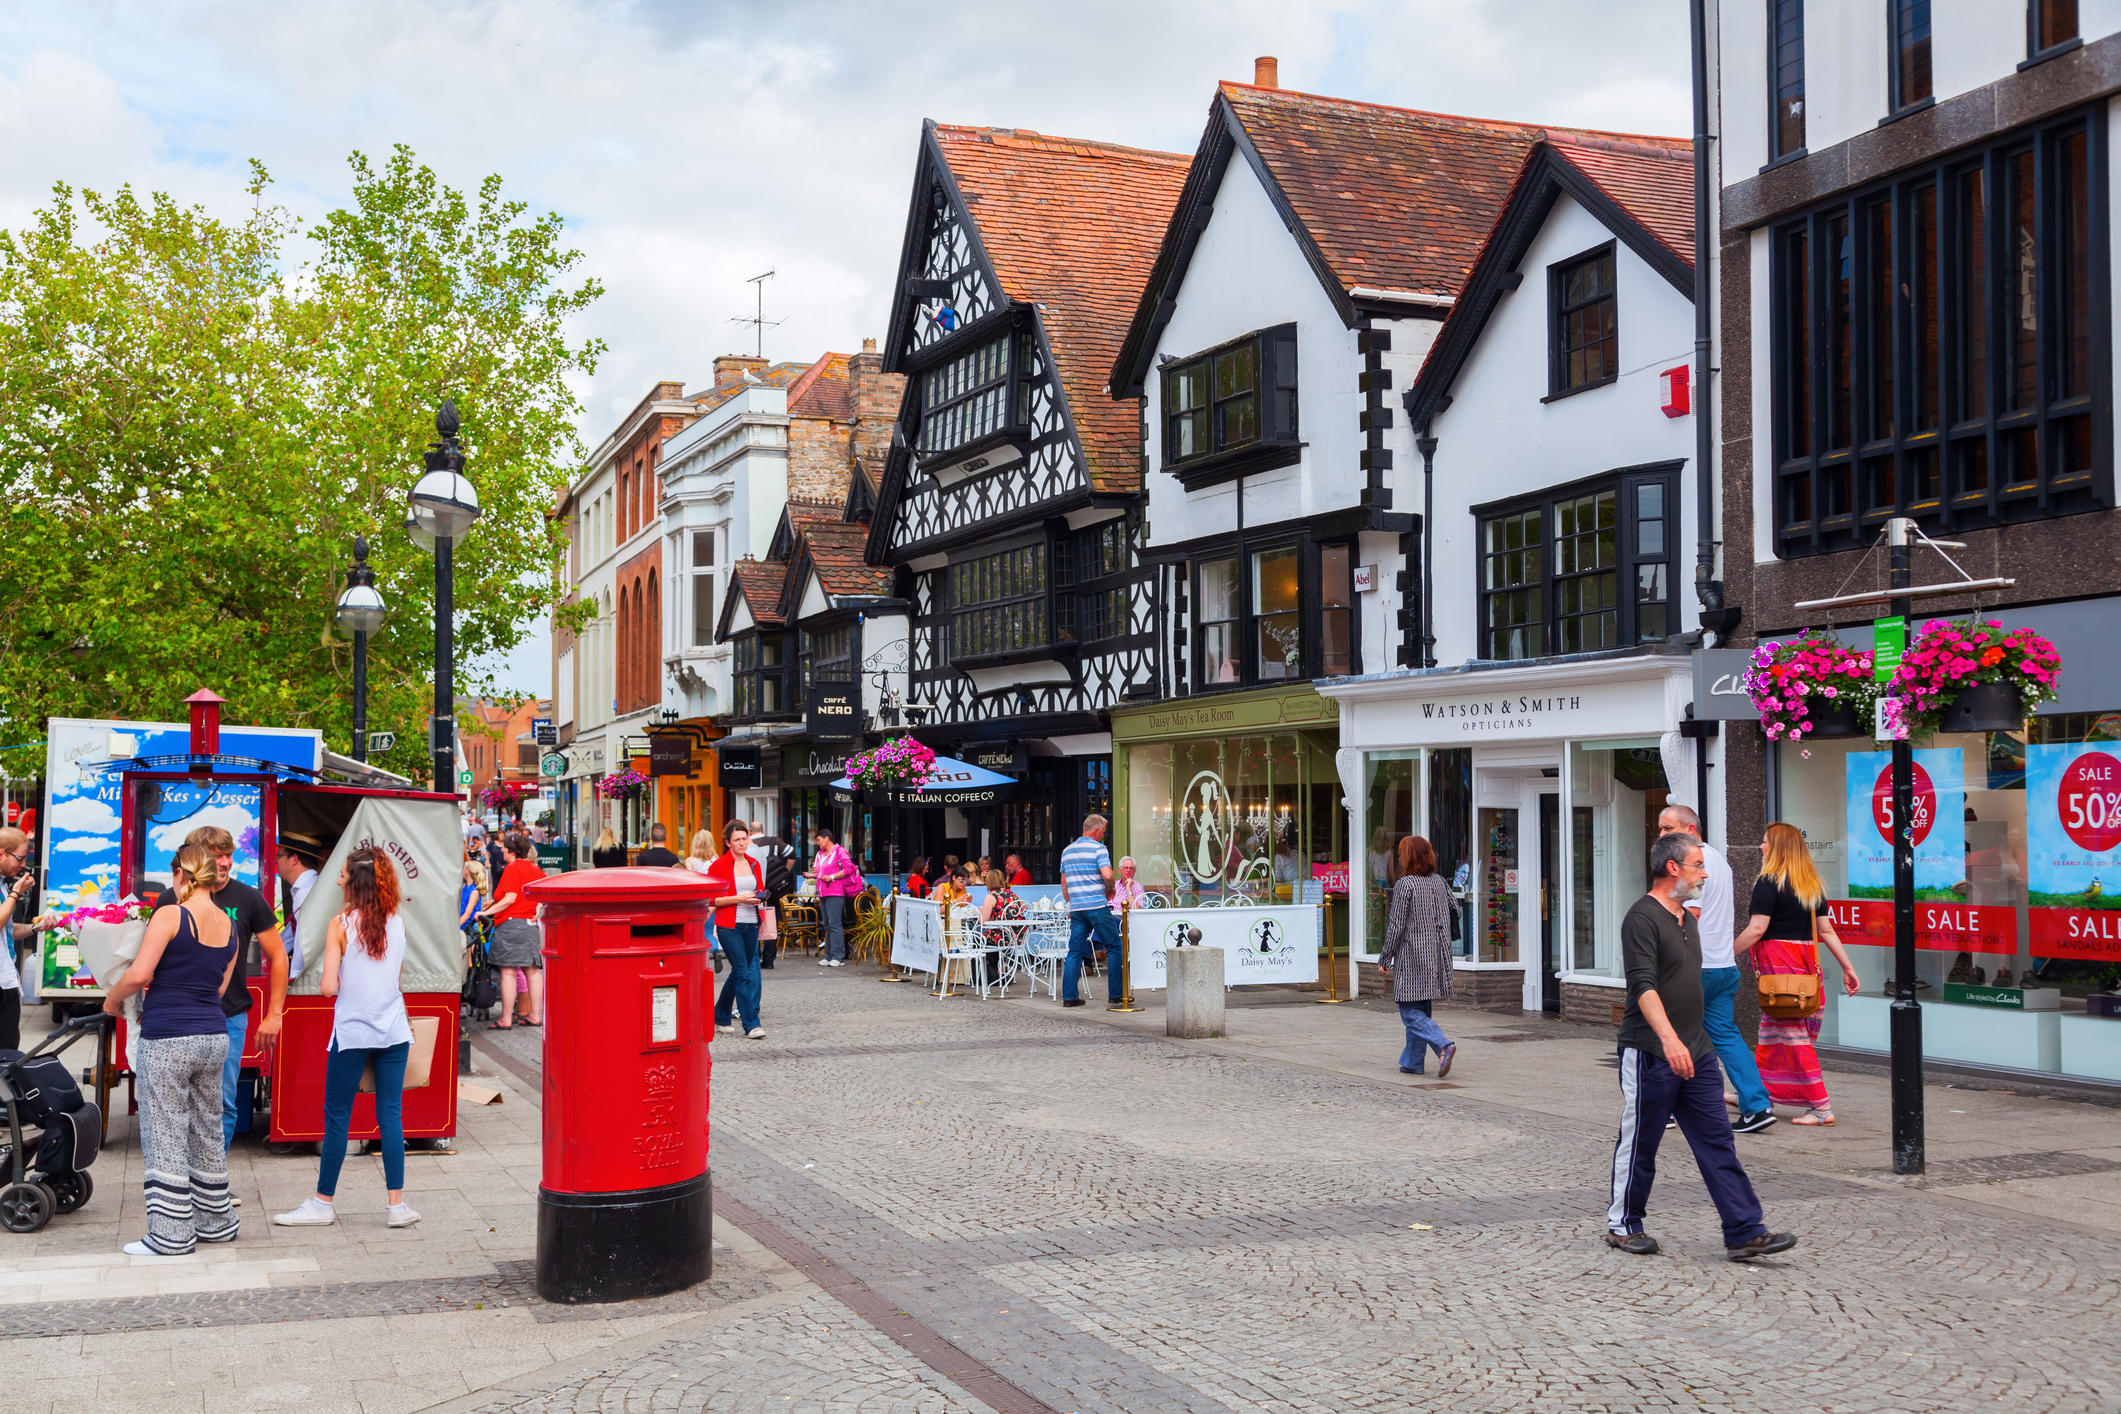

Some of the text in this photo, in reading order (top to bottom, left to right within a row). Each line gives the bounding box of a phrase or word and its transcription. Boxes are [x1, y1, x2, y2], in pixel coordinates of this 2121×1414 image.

[1711, 674, 1748, 696] Cla
[818, 705, 852, 714] NERO
[1329, 699, 1338, 711] 16
[1422, 696, 1580, 718] WATSON & SMITH
[1150, 708, 1235, 731] Daisy May's Tea Room
[1462, 719, 1532, 730] OPTICIANS
[653, 751, 684, 760] orchard
[809, 751, 848, 775] Chocolat
[927, 772, 973, 783] ERO
[2079, 767, 2112, 781] SALE
[888, 792, 905, 802] TE
[908, 794, 942, 802] ITALIAN
[945, 793, 980, 802] COFFEE
[1881, 796, 1928, 828] 5%
[2068, 792, 2121, 829] 50%
[1828, 906, 1860, 925] ALE
[1927, 909, 1979, 931] SALE
[1836, 927, 1883, 938] EDUCTIONS
[1915, 931, 2005, 945] RTHER REDUCTIONS
[2057, 940, 2102, 951] SANDALS
[1241, 957, 1292, 968] Daisy May's
[1996, 993, 2020, 1004] Clarks
[634, 1132, 683, 1154] ROYAL
[640, 1150, 680, 1170] MAIL
